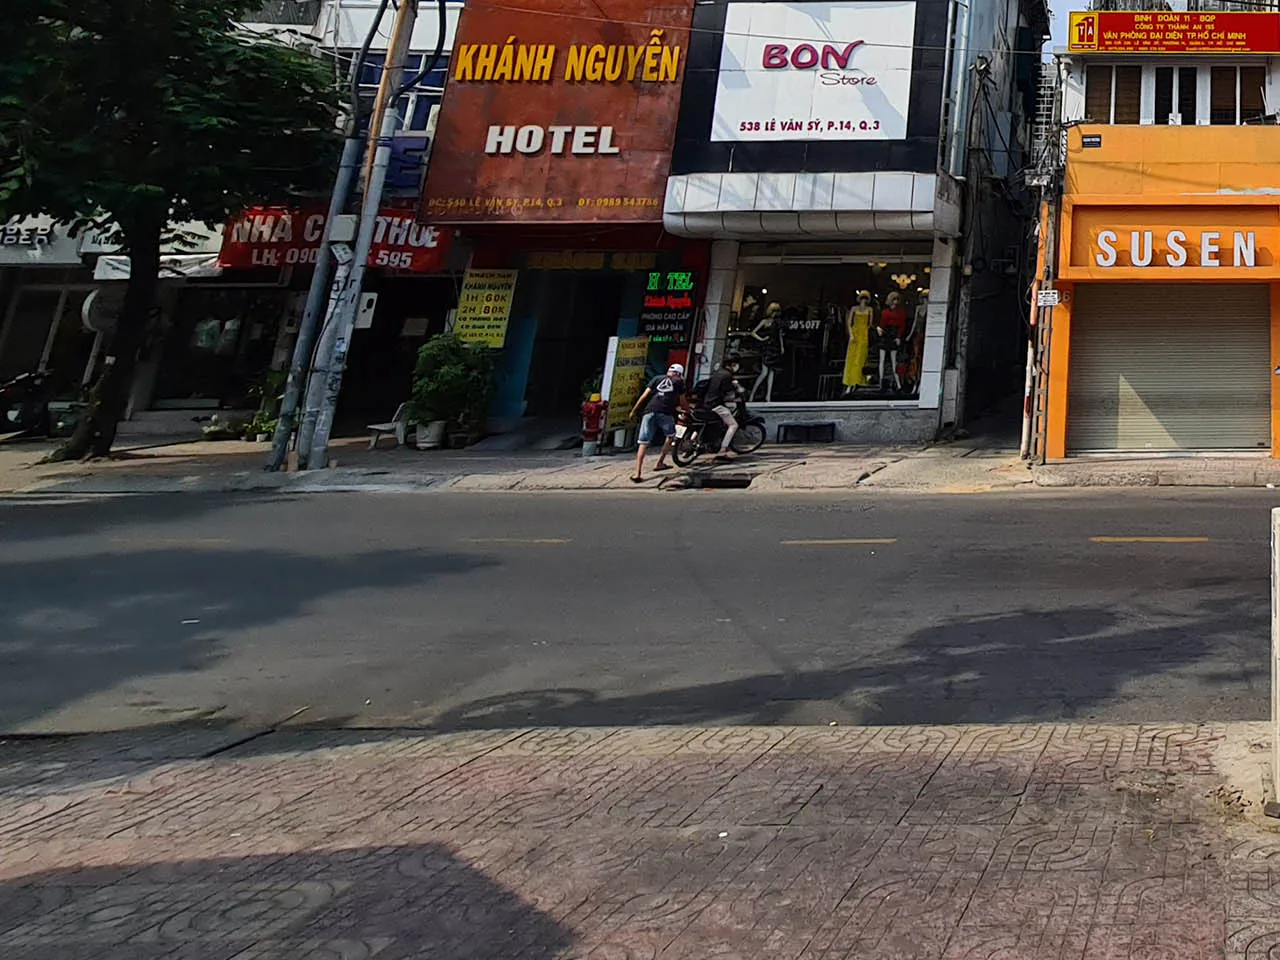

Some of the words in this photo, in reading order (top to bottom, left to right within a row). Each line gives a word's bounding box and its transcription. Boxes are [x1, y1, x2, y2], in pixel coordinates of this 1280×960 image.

[454, 36, 556, 82] KHÁNH
[564, 29, 681, 82] NGUYỄN
[762, 40, 864, 70] BON
[820, 73, 878, 86] Store
[484, 125, 620, 154] HOTEL
[739, 121, 761, 131] 538
[764, 118, 776, 131] LÊ
[827, 120, 856, 132] P.14,
[859, 120, 880, 131] Q.3
[1096, 230, 1256, 267] SUSEN
